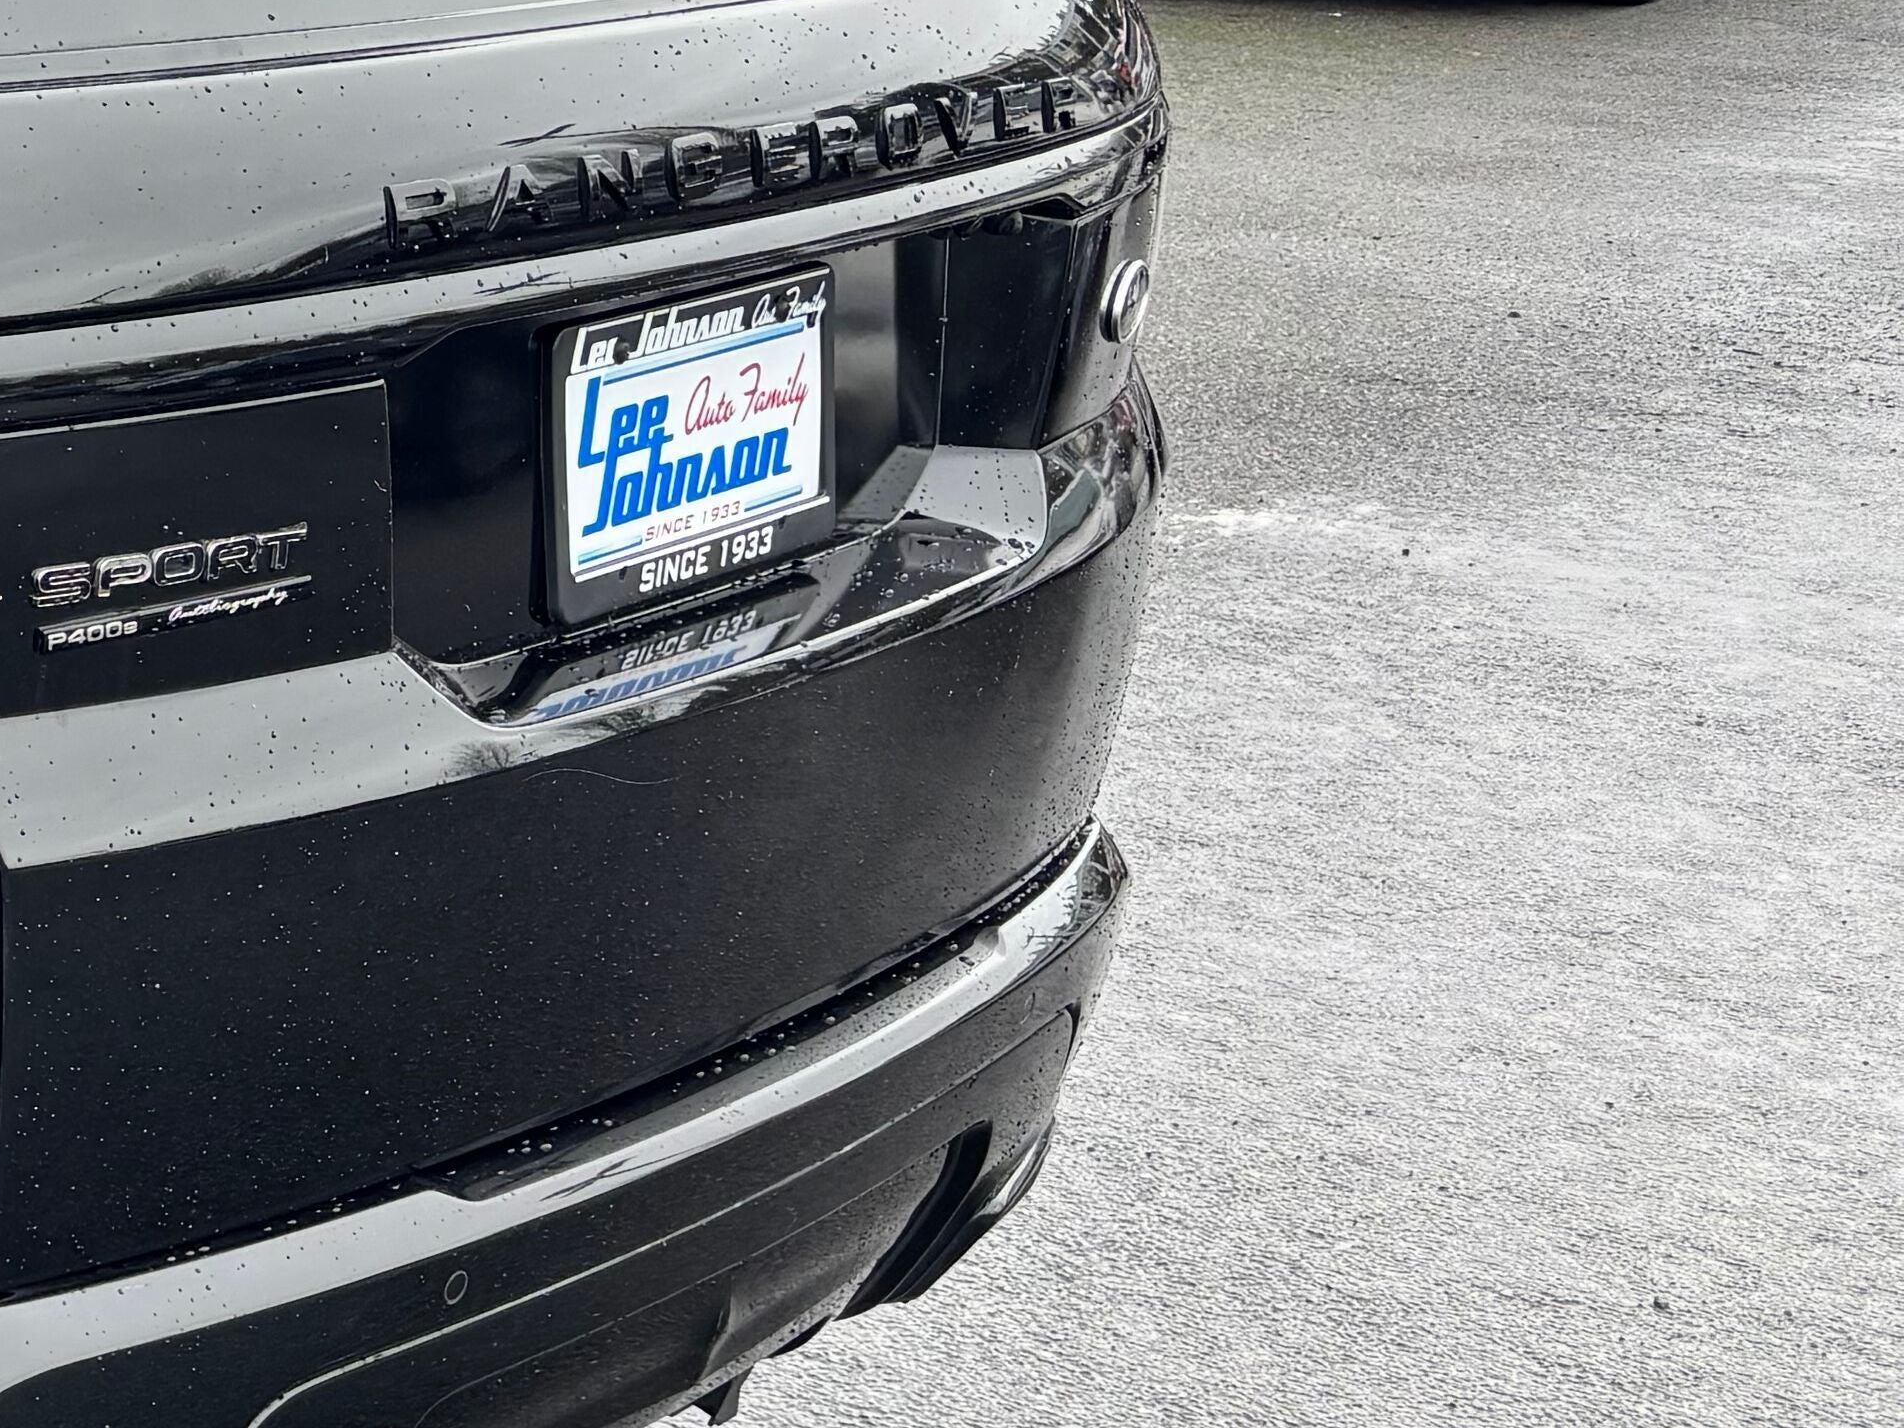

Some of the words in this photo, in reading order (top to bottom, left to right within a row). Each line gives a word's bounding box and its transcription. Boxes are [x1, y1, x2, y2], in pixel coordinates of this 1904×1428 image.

[626, 306, 745, 359] Johnson
[785, 280, 827, 330] Family
[578, 375, 670, 468] Lee
[684, 375, 736, 435] Auto
[739, 353, 809, 426] Family
[581, 427, 793, 537] Johnson
[644, 514, 695, 542] SINCE
[702, 500, 742, 525] 1933
[29, 521, 309, 608] SPORT
[638, 543, 712, 593] SINCE
[720, 525, 774, 567] 1933
[47, 620, 138, 651] P400e
[168, 587, 289, 623] Autobiography
